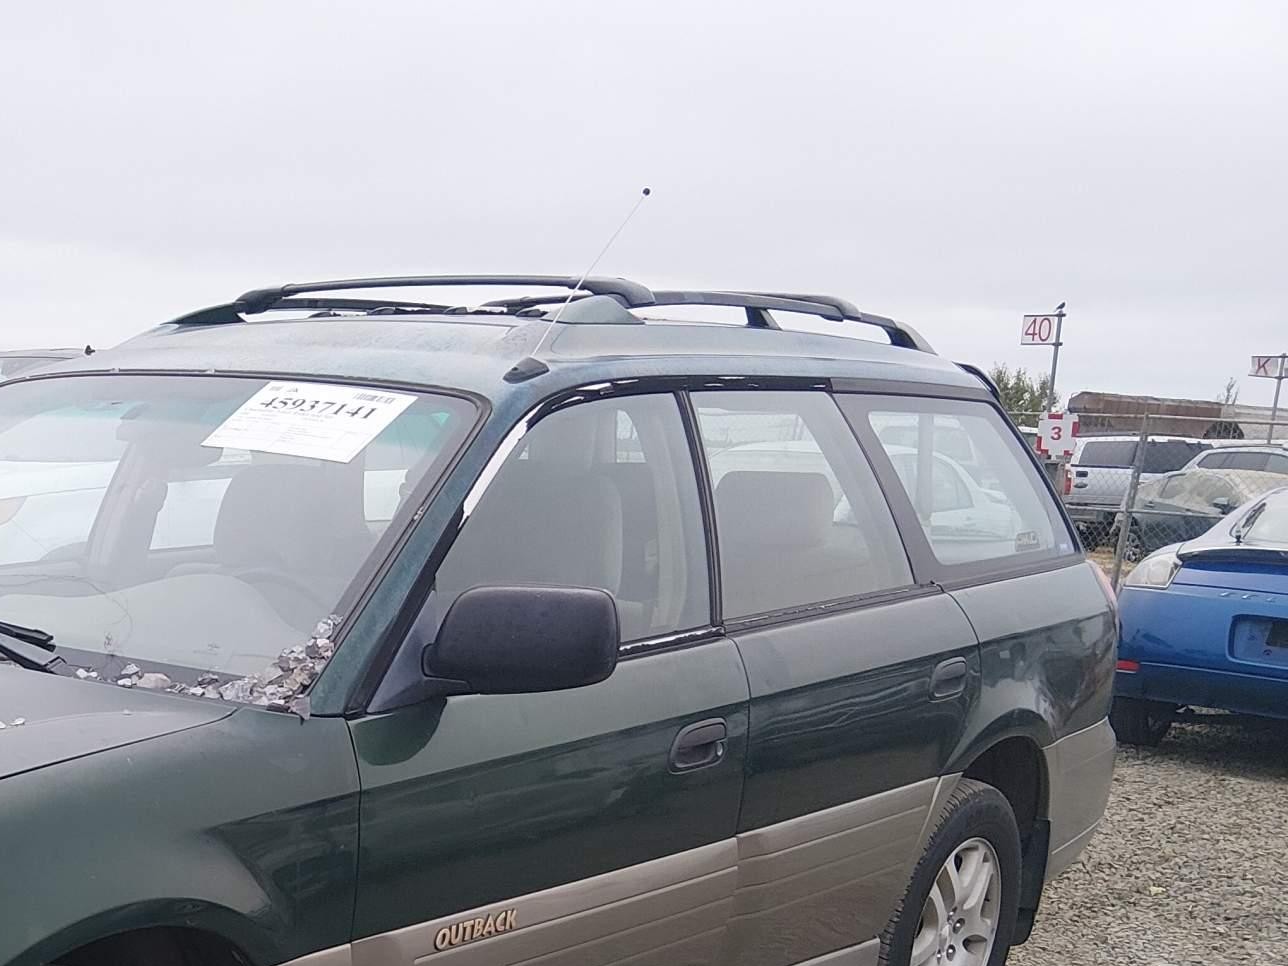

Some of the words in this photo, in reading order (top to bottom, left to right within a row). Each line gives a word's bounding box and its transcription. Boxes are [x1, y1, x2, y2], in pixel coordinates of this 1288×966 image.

[1024, 317, 1052, 342] 40
[1255, 357, 1271, 376] K
[259, 396, 377, 419] 45937141
[1050, 425, 1062, 441] 3
[434, 910, 518, 951] OUTBACK
